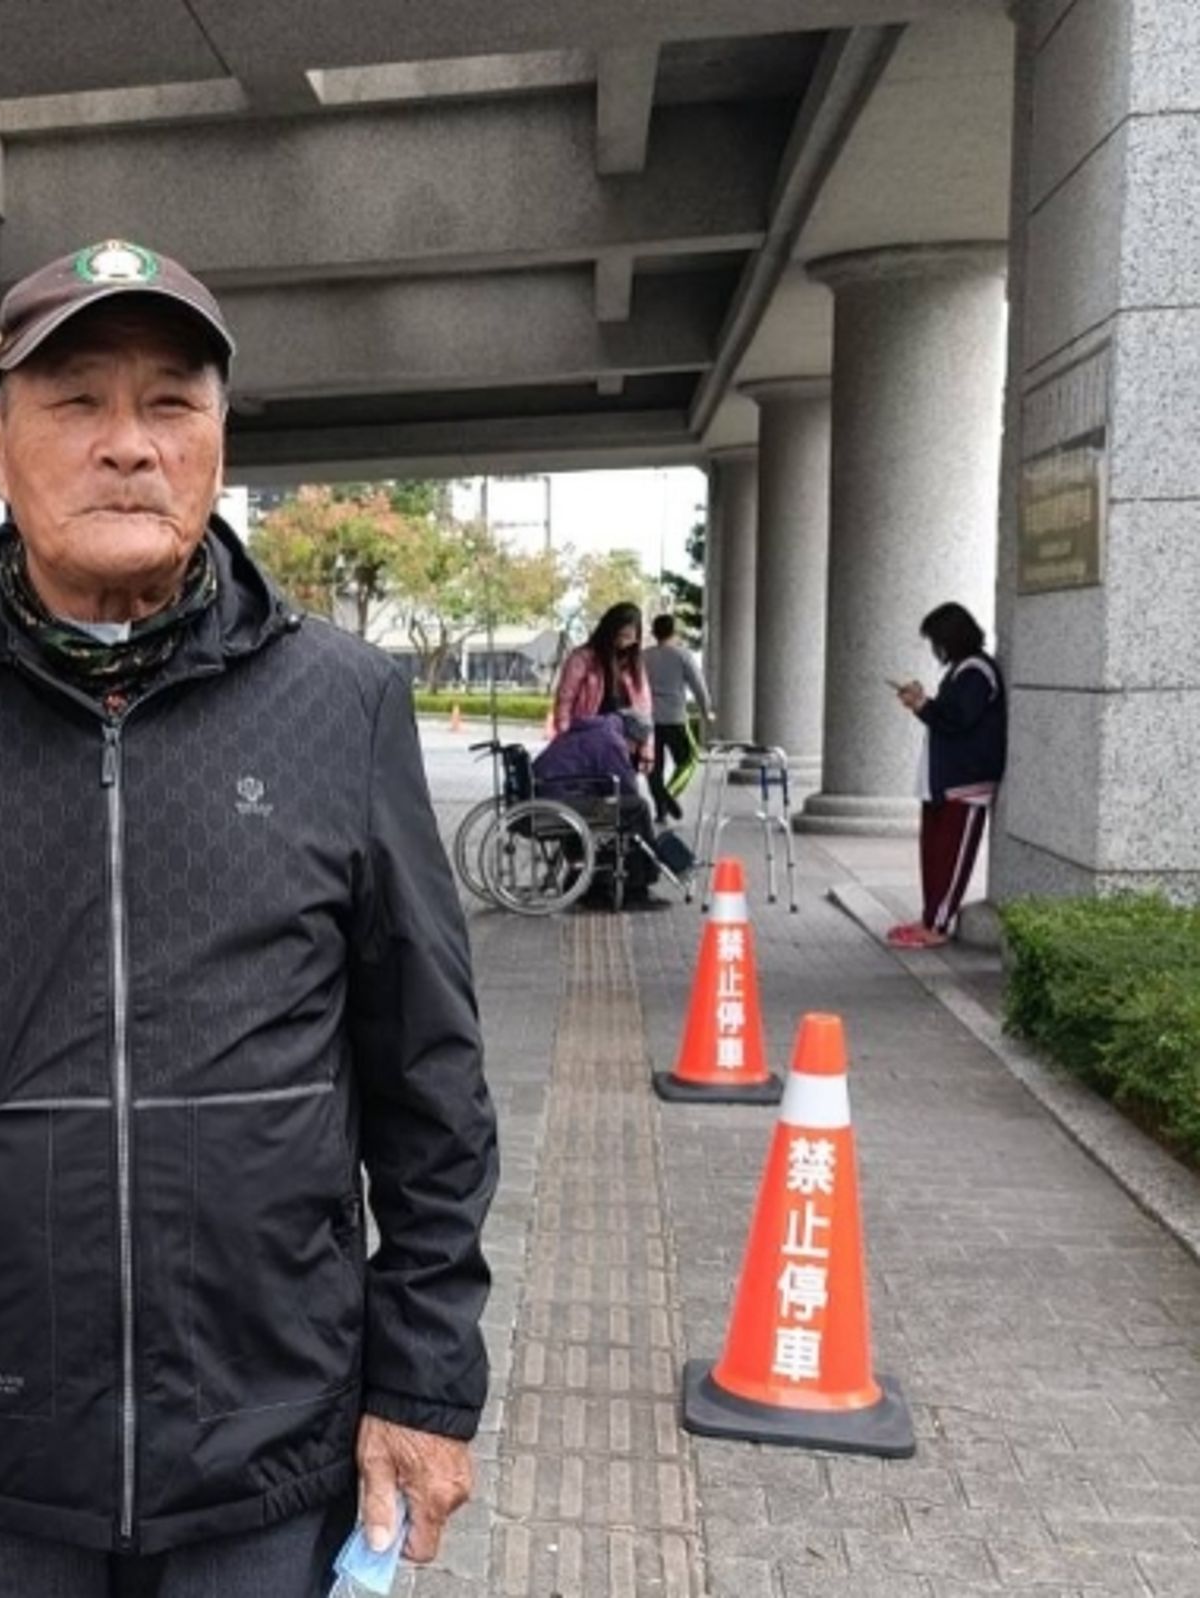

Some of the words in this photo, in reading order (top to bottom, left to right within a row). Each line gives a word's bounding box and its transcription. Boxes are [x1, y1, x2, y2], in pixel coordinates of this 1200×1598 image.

[716, 926, 746, 1070] 禁止停車
[771, 1137, 837, 1382] 禁止停車
